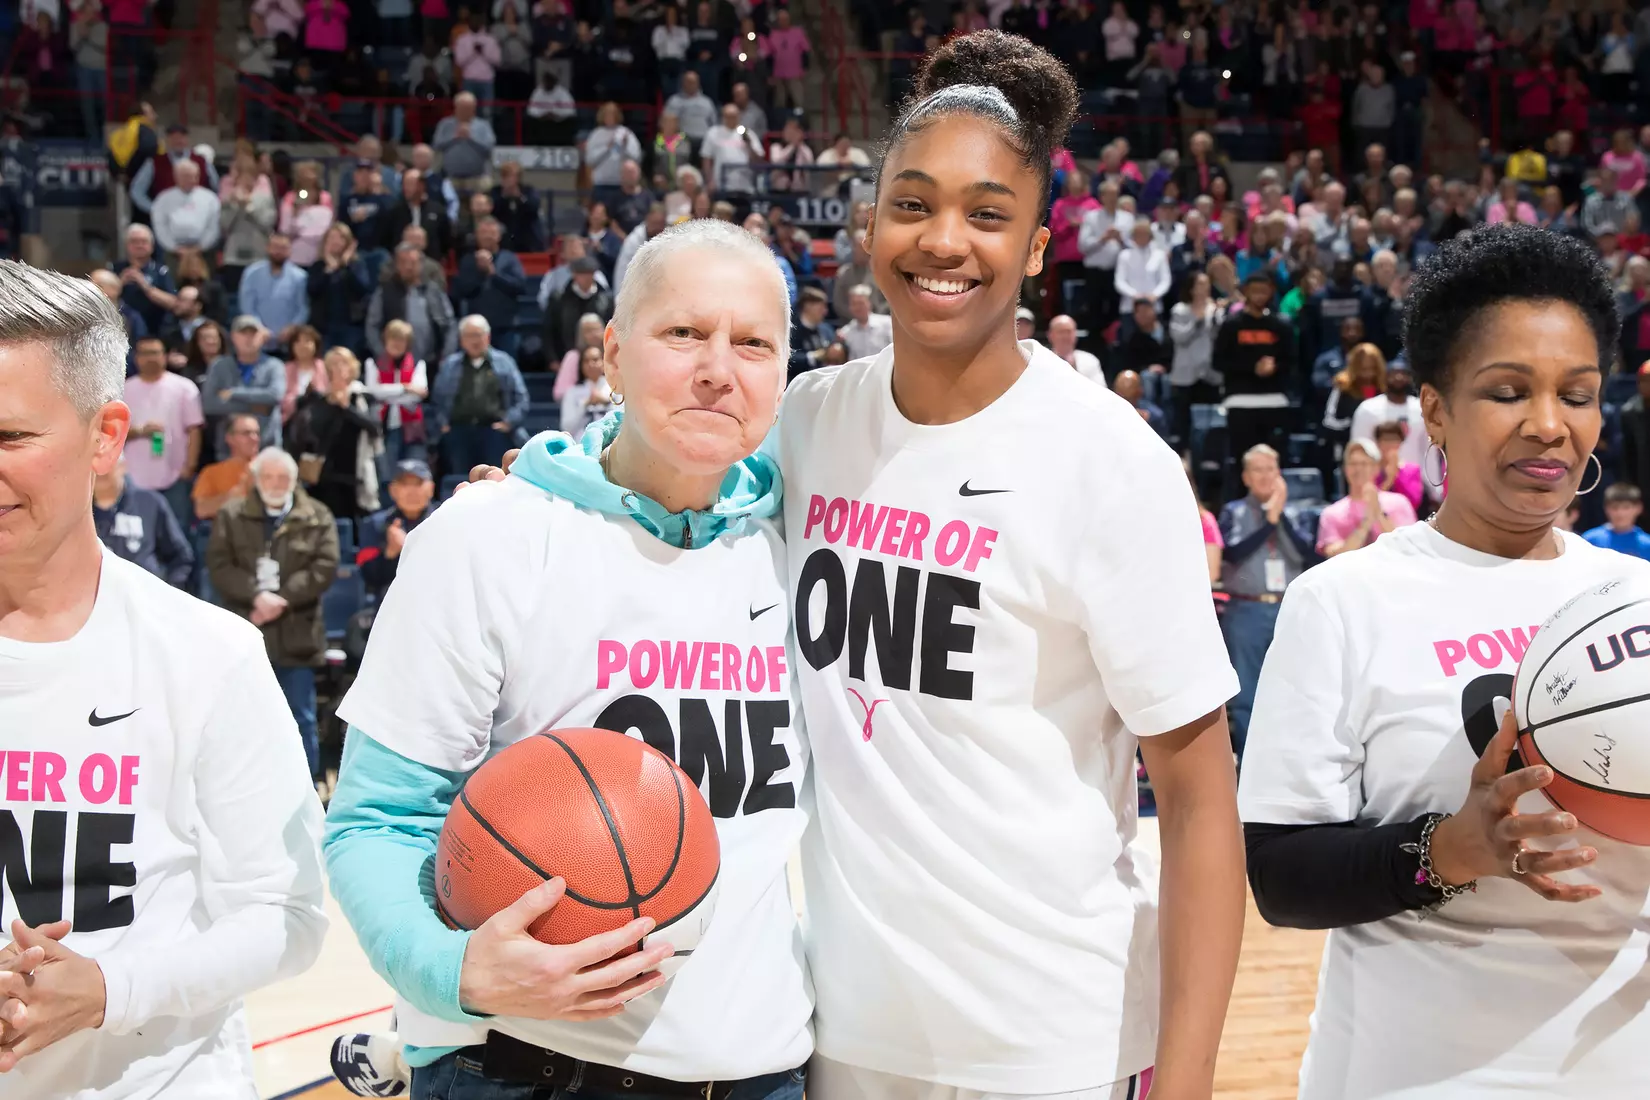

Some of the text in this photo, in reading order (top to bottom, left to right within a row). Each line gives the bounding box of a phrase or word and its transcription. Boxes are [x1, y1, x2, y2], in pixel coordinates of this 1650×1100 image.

[533, 148, 579, 169] 210
[796, 197, 845, 222] 110
[803, 494, 998, 573] POWER OF
[796, 548, 981, 701] ONE
[596, 639, 788, 693] POWER OF
[78, 752, 140, 805] OF
